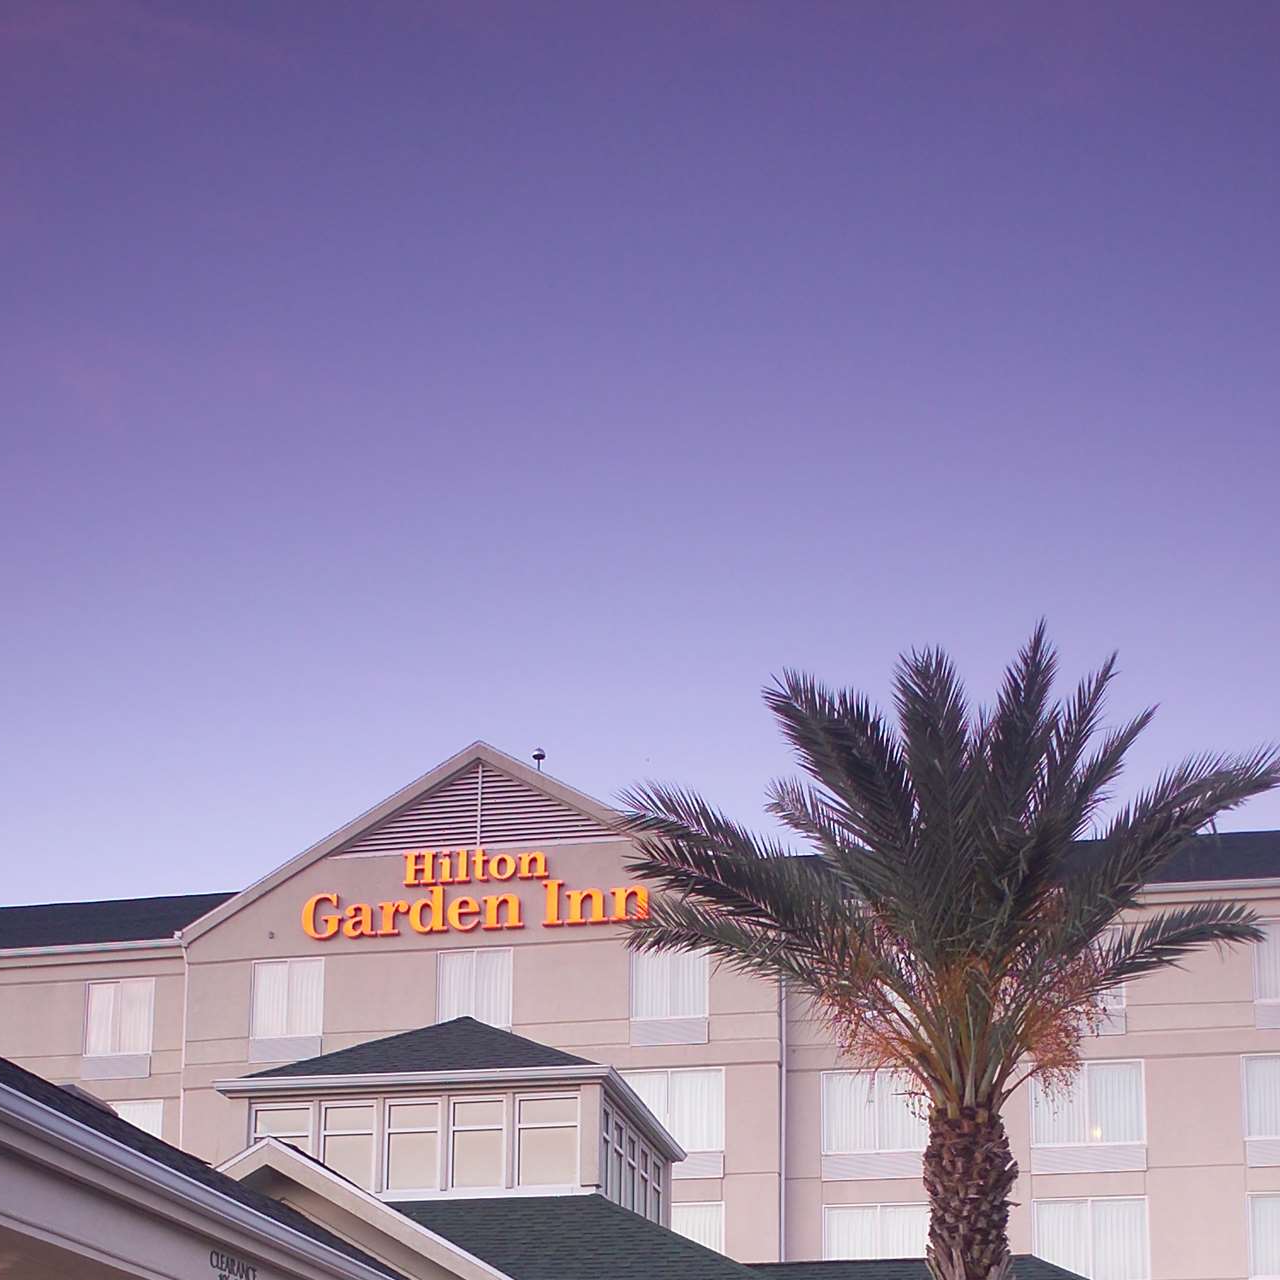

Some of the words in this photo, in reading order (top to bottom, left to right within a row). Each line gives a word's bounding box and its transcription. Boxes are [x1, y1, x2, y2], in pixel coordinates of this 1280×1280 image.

[403, 848, 549, 887] Hilton
[301, 886, 524, 940] Garden
[542, 880, 650, 927] Inn
